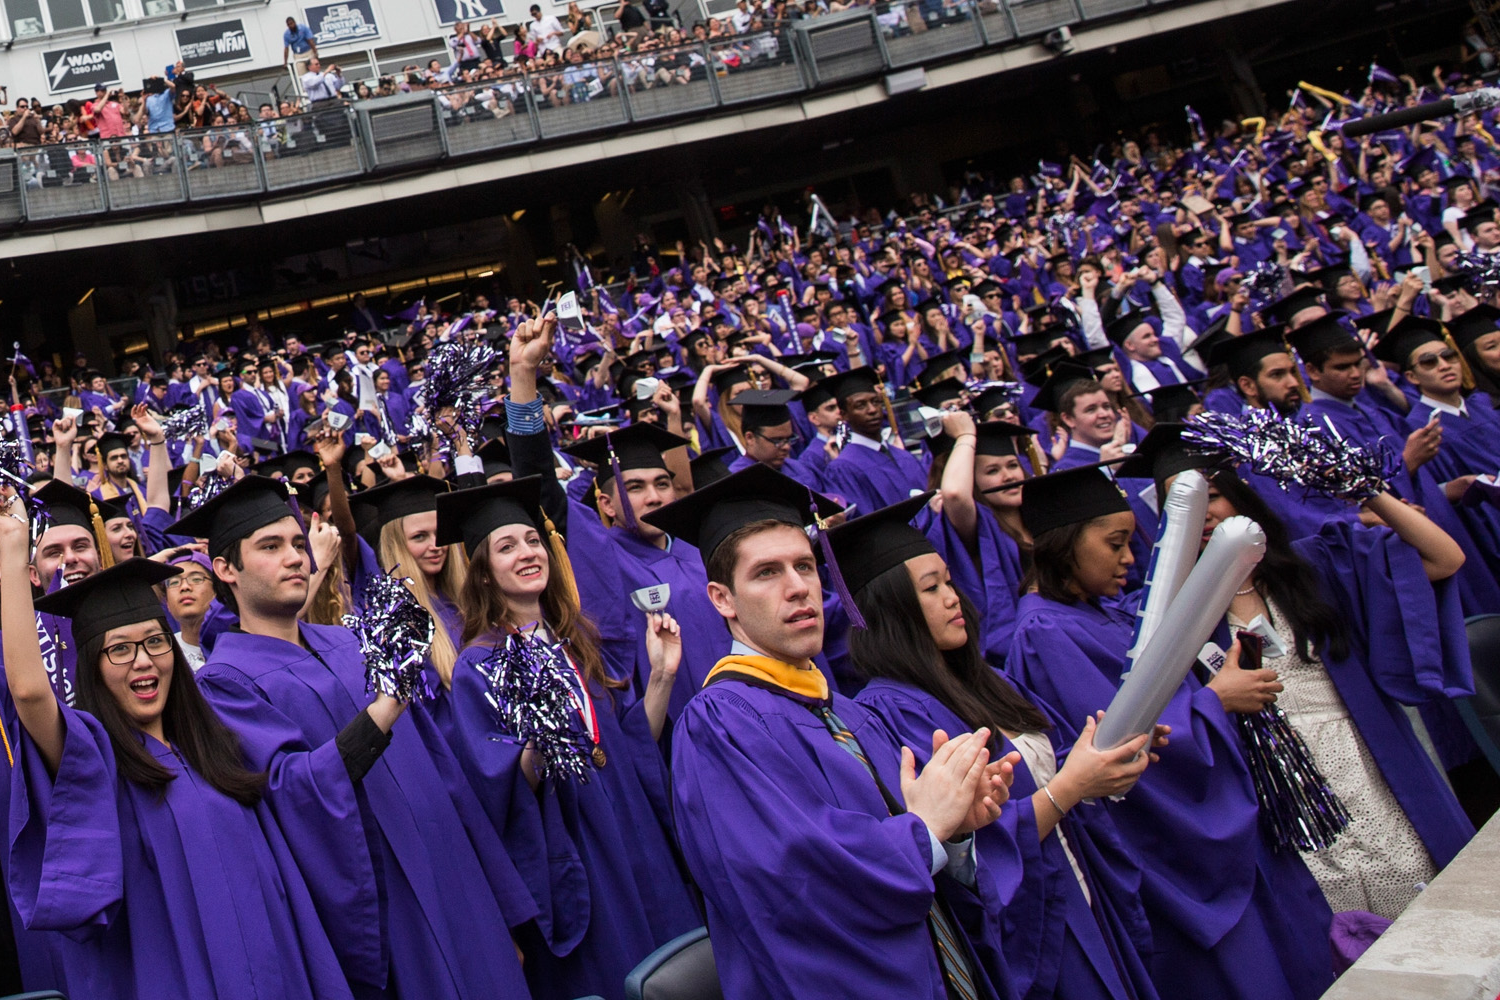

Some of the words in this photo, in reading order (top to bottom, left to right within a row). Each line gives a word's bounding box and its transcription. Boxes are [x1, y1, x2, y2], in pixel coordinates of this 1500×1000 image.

[215, 30, 246, 54] WFAN
[67, 50, 114, 67] WADO
[71, 66, 91, 75] 1280
[92, 63, 105, 72] AM
